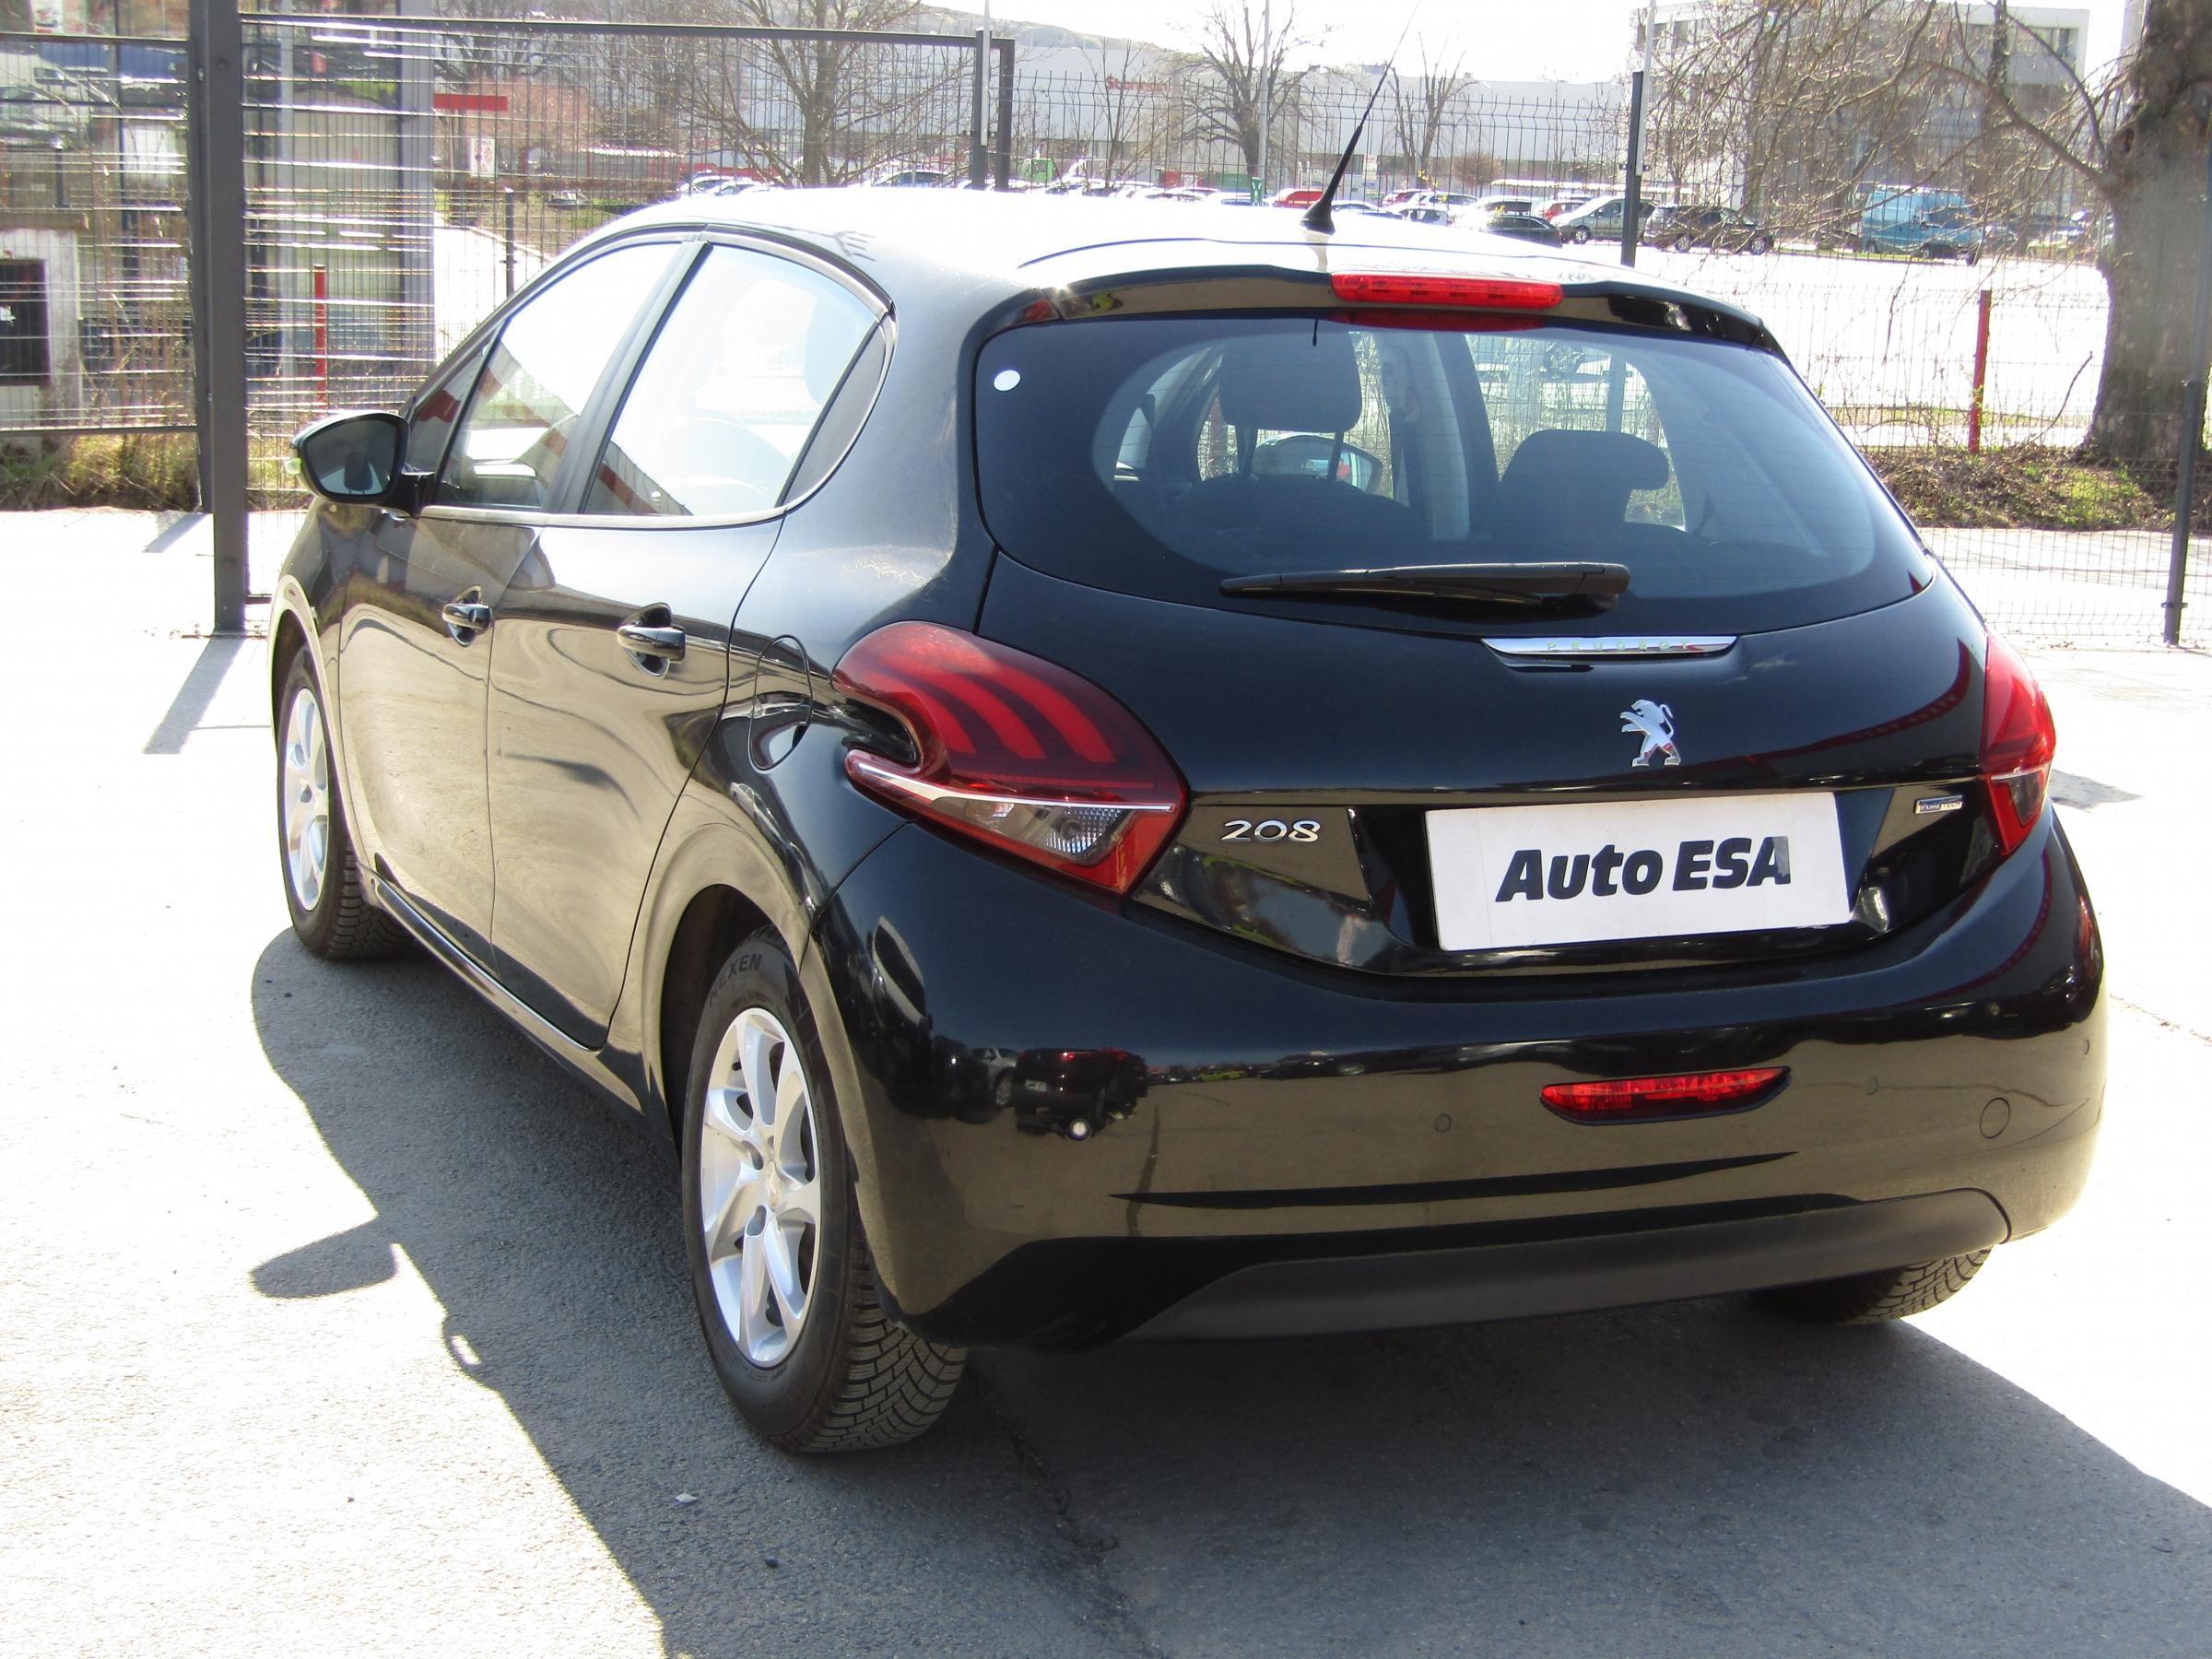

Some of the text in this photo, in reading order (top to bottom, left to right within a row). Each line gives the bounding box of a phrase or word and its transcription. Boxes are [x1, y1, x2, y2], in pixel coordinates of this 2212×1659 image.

[1547, 641, 1689, 651] PEUGEOT
[1221, 819, 1321, 842] 208
[1496, 836, 1791, 901] Auto ESA
